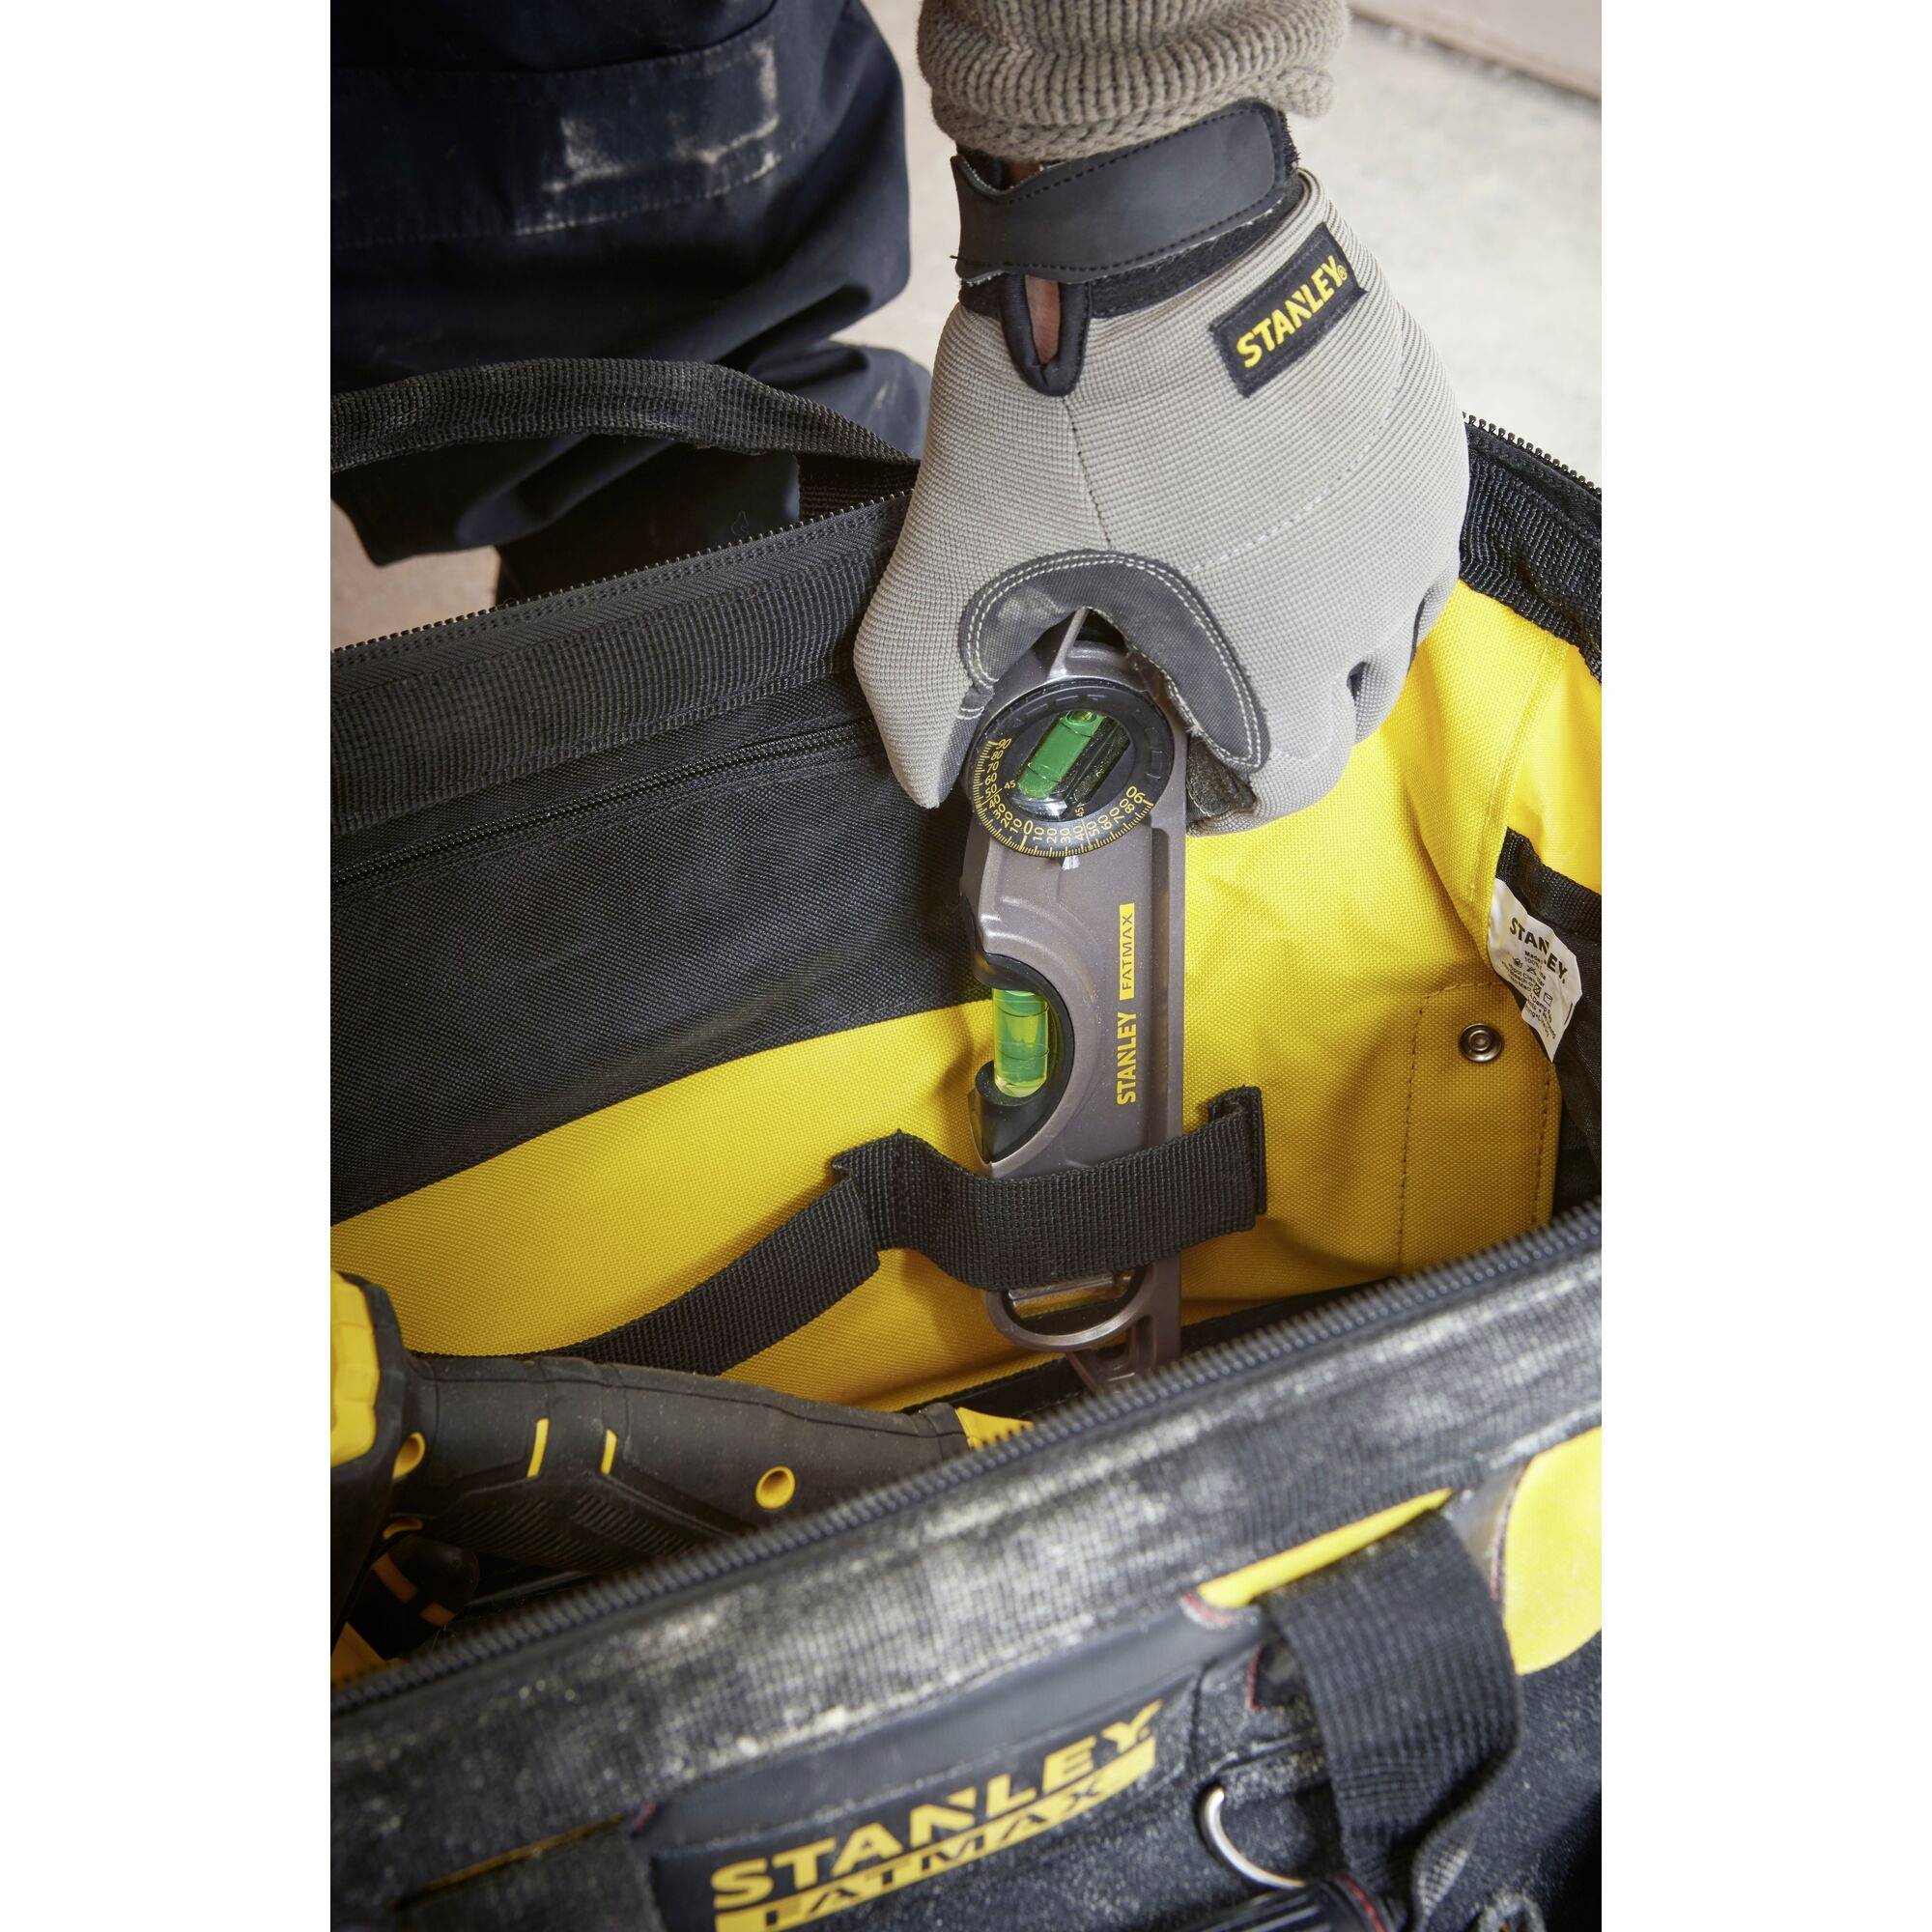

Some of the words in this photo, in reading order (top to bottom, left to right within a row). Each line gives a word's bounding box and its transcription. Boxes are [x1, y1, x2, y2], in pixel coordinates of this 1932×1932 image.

[1236, 254, 1345, 368] STANLEY
[996, 738, 1012, 750] 90
[991, 750, 1005, 761] 80
[986, 761, 999, 773] 70
[985, 773, 997, 785] 60
[1004, 780, 1016, 790] 45
[985, 783, 998, 799] 50
[1125, 785, 1146, 804] 90
[988, 794, 1001, 810] 40
[1119, 798, 1135, 813] 80
[993, 804, 1006, 820] 30
[1001, 811, 1013, 828] 20
[1109, 807, 1125, 824] 70
[1009, 818, 1022, 834] 10
[1024, 820, 1034, 836] 0
[1086, 821, 1100, 837] 50
[1097, 814, 1112, 830] 60
[1033, 827, 1044, 841] 10
[1046, 828, 1058, 843] 20
[1060, 828, 1071, 844] 30
[1073, 825, 1085, 841] 40
[1121, 910, 1135, 992] FATMAX
[1509, 917, 1569, 981] STANEY
[1117, 1011, 1137, 1105] STANLEY
[710, 1698, 1163, 1910] STANLEY
[753, 1771, 1106, 1929] FATMAX
